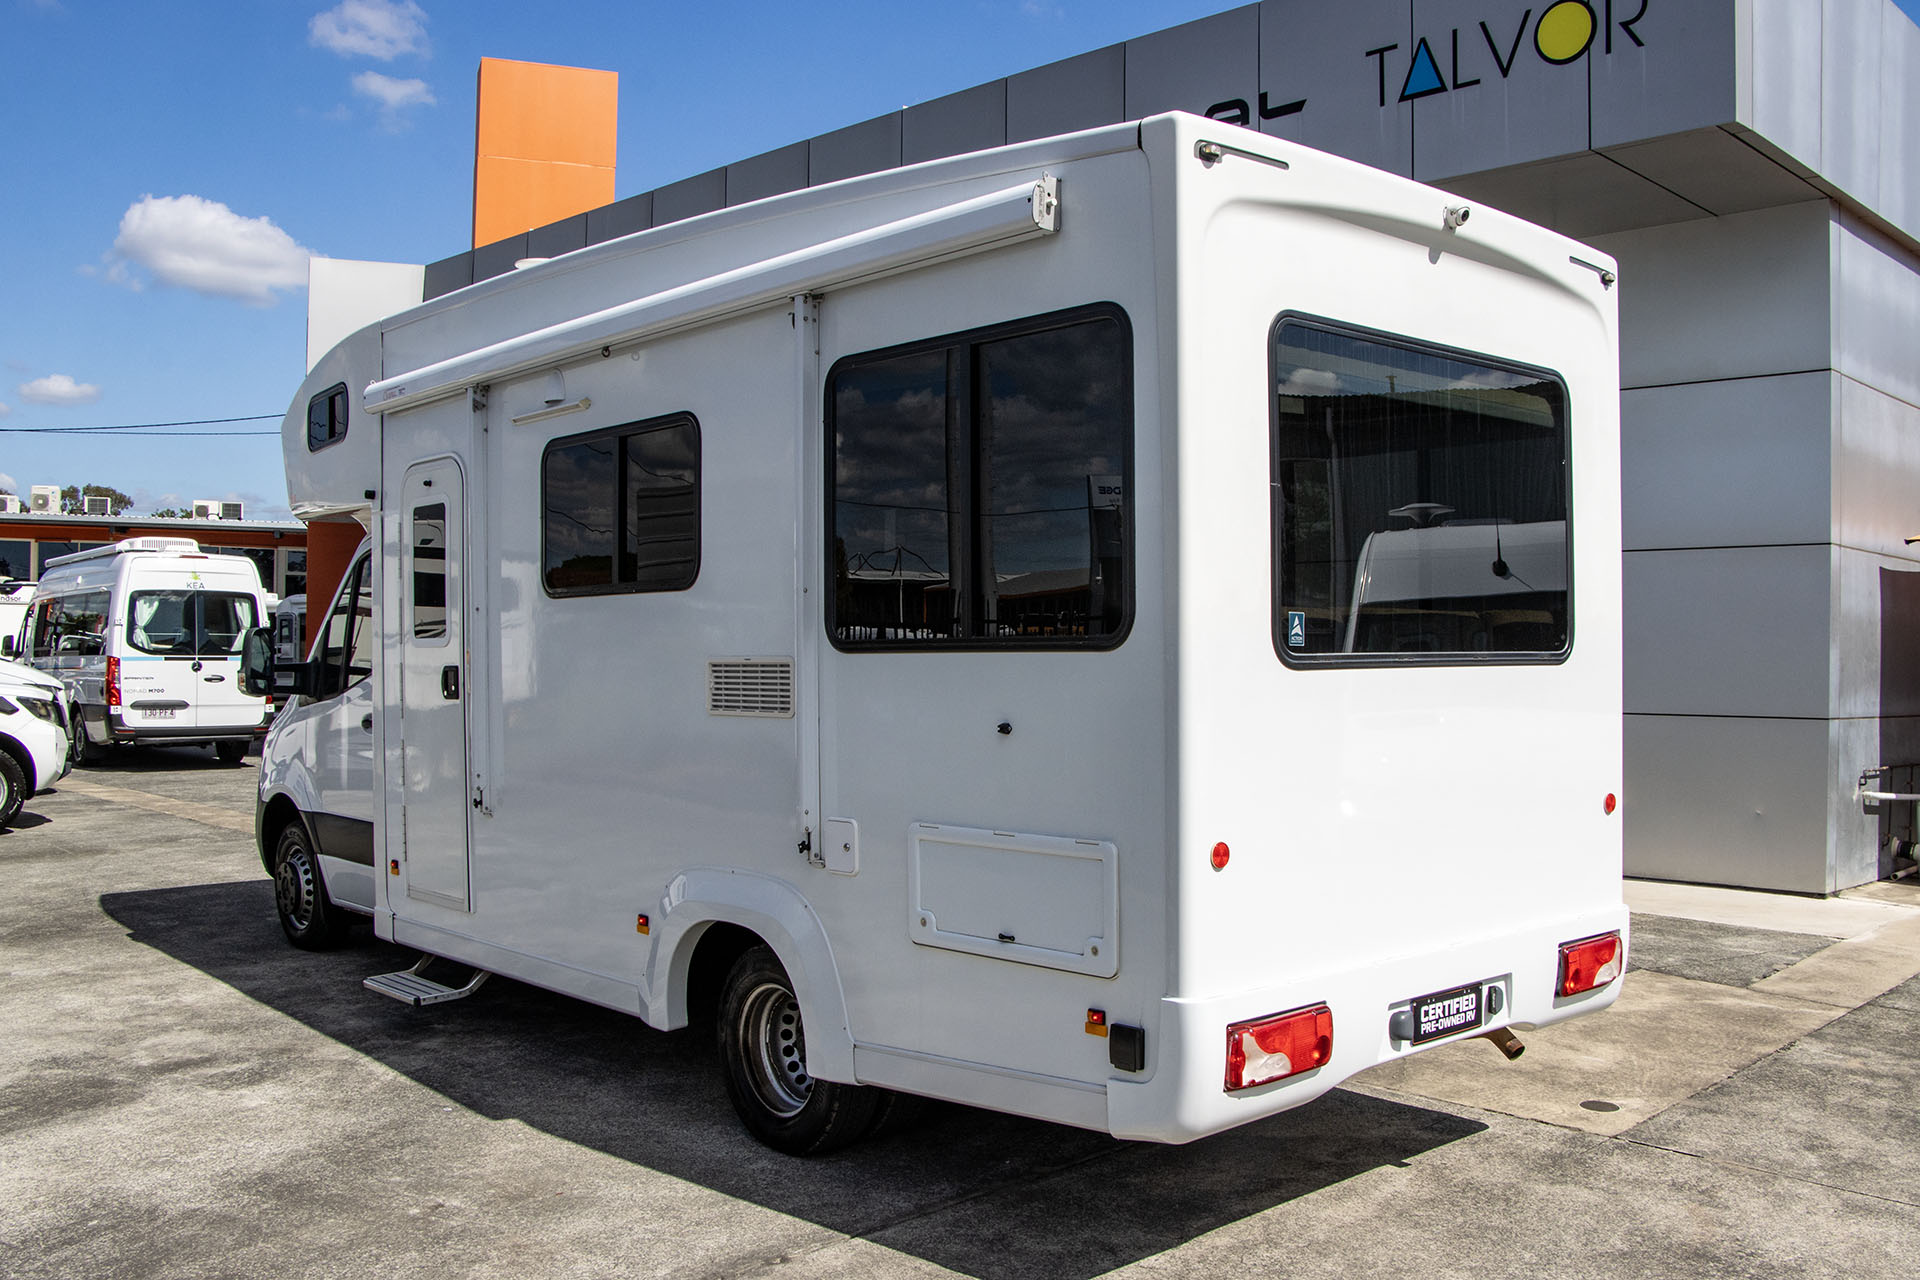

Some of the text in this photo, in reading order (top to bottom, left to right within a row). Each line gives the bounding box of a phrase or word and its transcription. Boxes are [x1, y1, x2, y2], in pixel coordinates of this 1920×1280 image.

[1365, 0, 1648, 107] TALVOR
[186, 582, 205, 590] KEA
[1420, 993, 1477, 1023] CERTIFIED
[1420, 1009, 1477, 1036] PRE-OWNED RV
